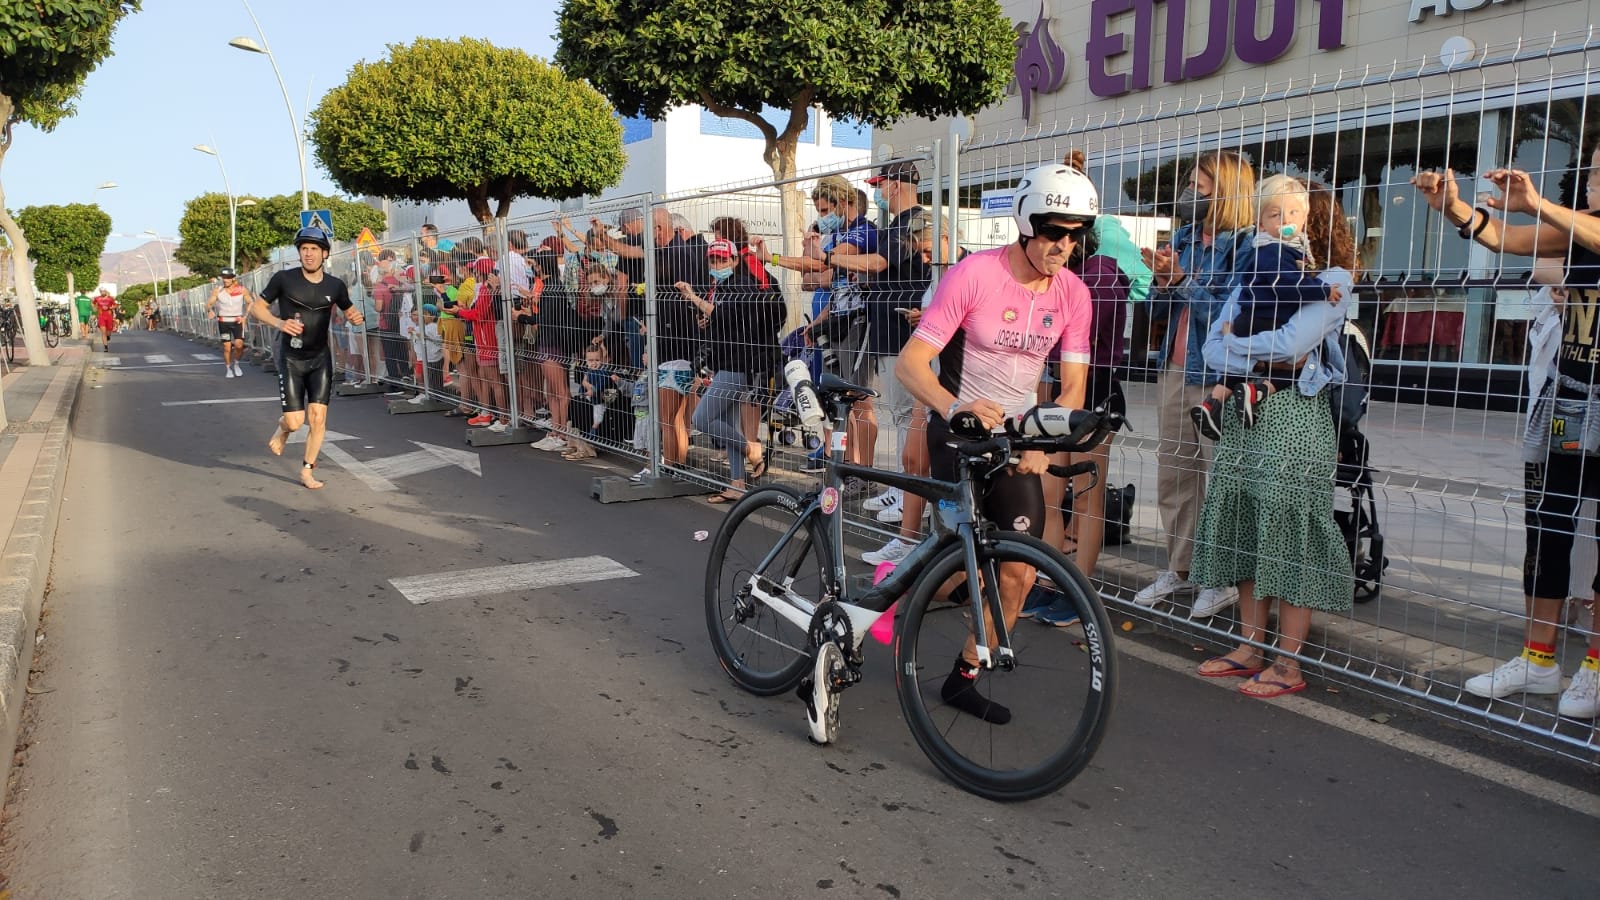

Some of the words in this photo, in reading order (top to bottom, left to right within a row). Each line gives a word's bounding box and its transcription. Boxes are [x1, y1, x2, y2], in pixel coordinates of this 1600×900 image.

[1045, 193, 1071, 208] 644
[744, 219, 777, 228] ANDORA
[994, 329, 1019, 348] JORGE
[962, 417, 975, 428] 3T
[1085, 622, 1101, 664] SWISS
[1092, 666, 1102, 692] DT
